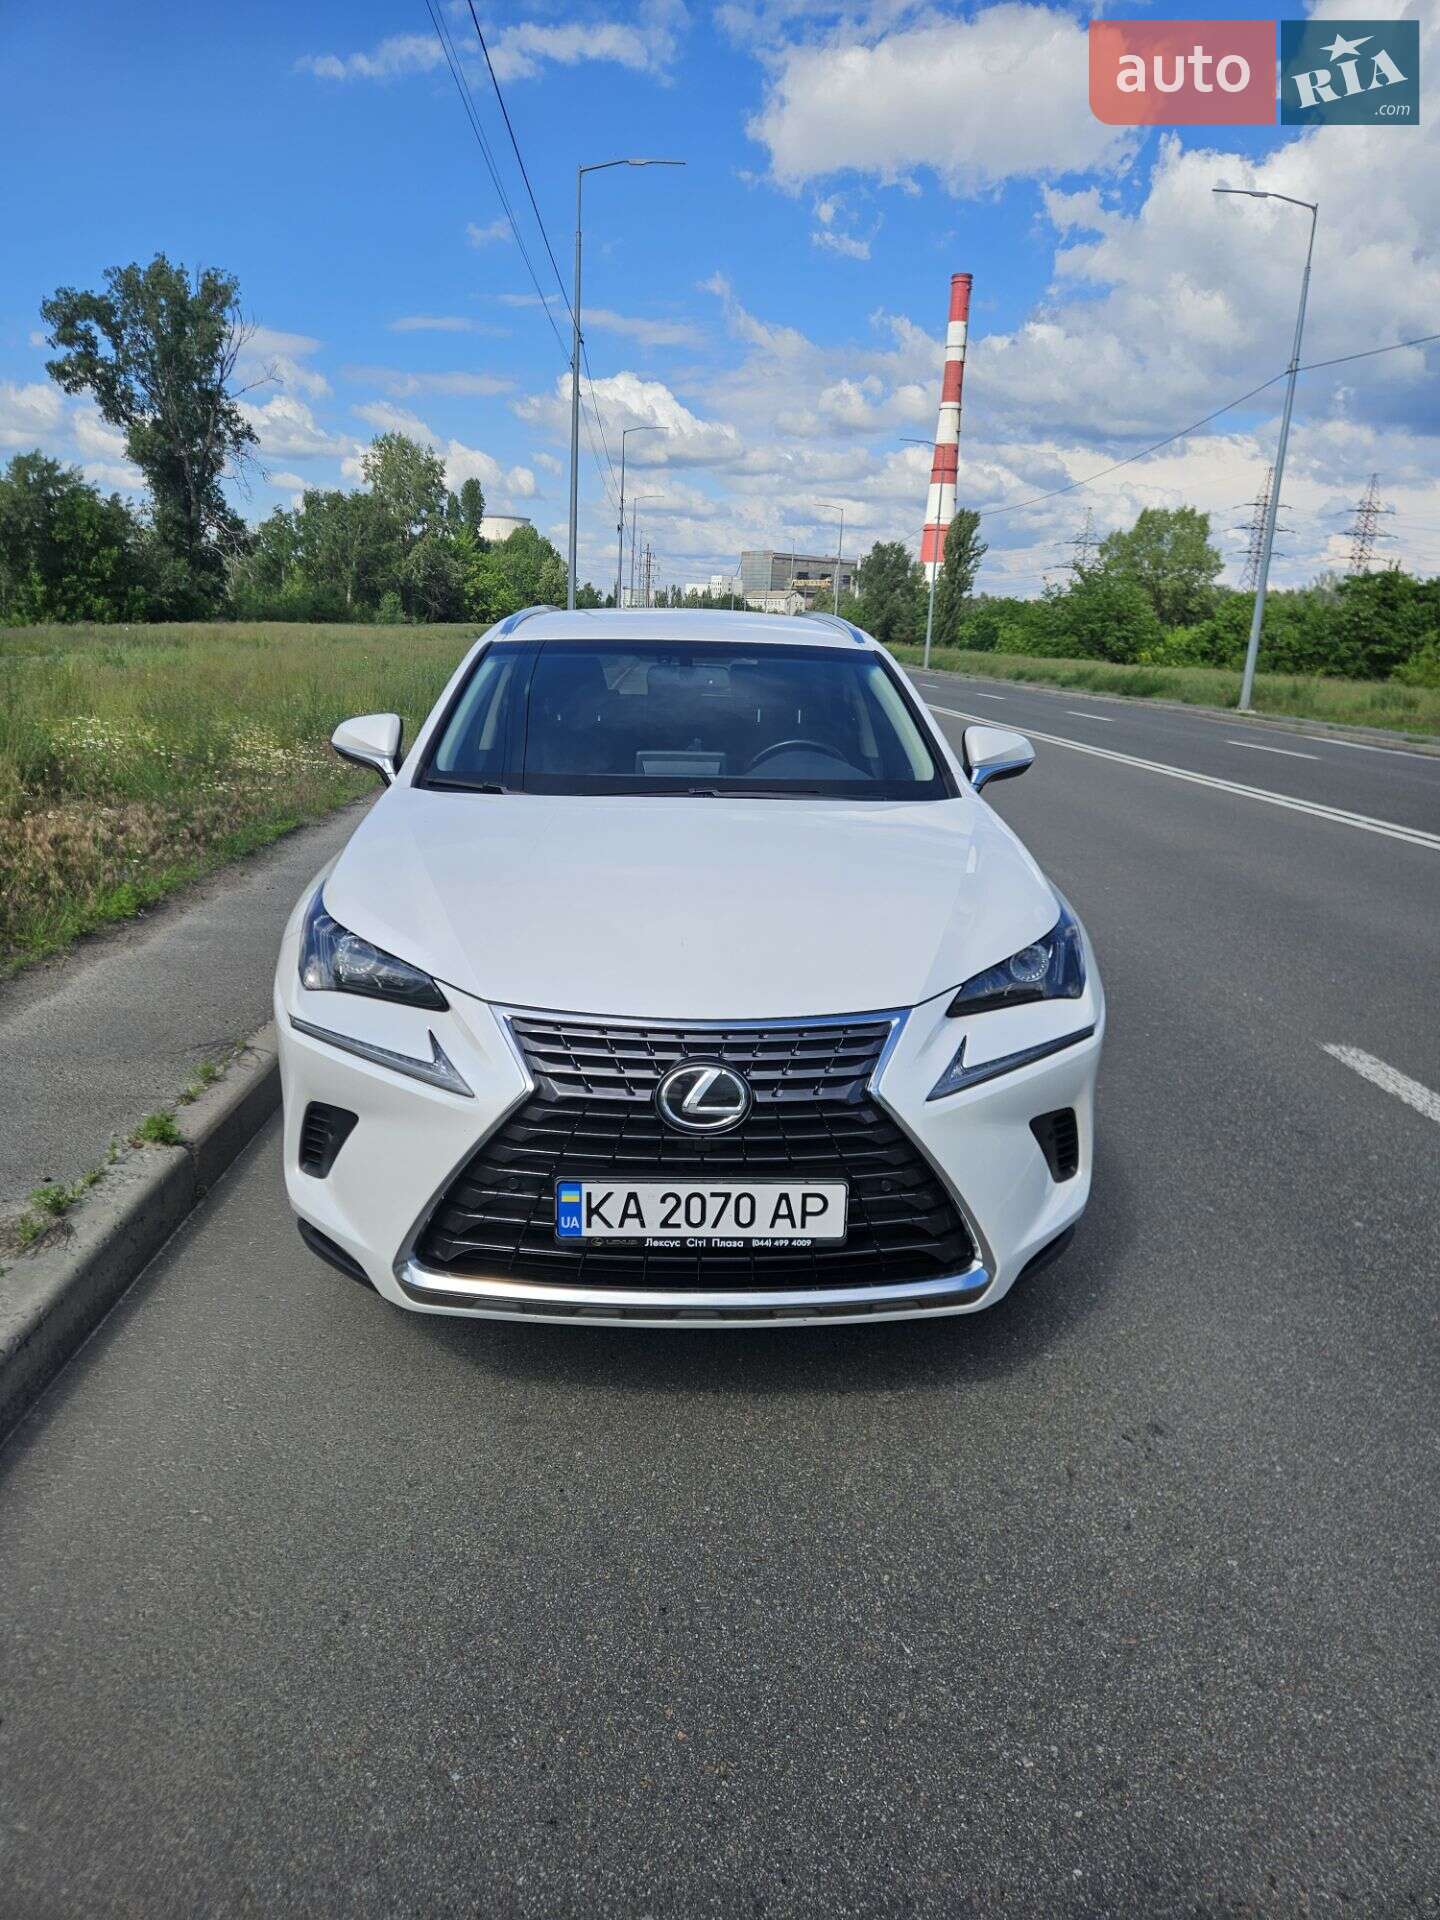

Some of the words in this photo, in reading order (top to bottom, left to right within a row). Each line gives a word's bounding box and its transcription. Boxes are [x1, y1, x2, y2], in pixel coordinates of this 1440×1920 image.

[586, 1192, 646, 1229] KA
[659, 1192, 756, 1229] 2070
[769, 1192, 829, 1229] AP
[561, 1216, 580, 1229] UA
[644, 1238, 681, 1248] Лексус
[711, 1238, 744, 1248] Плаза
[752, 1239, 772, 1248] (044)
